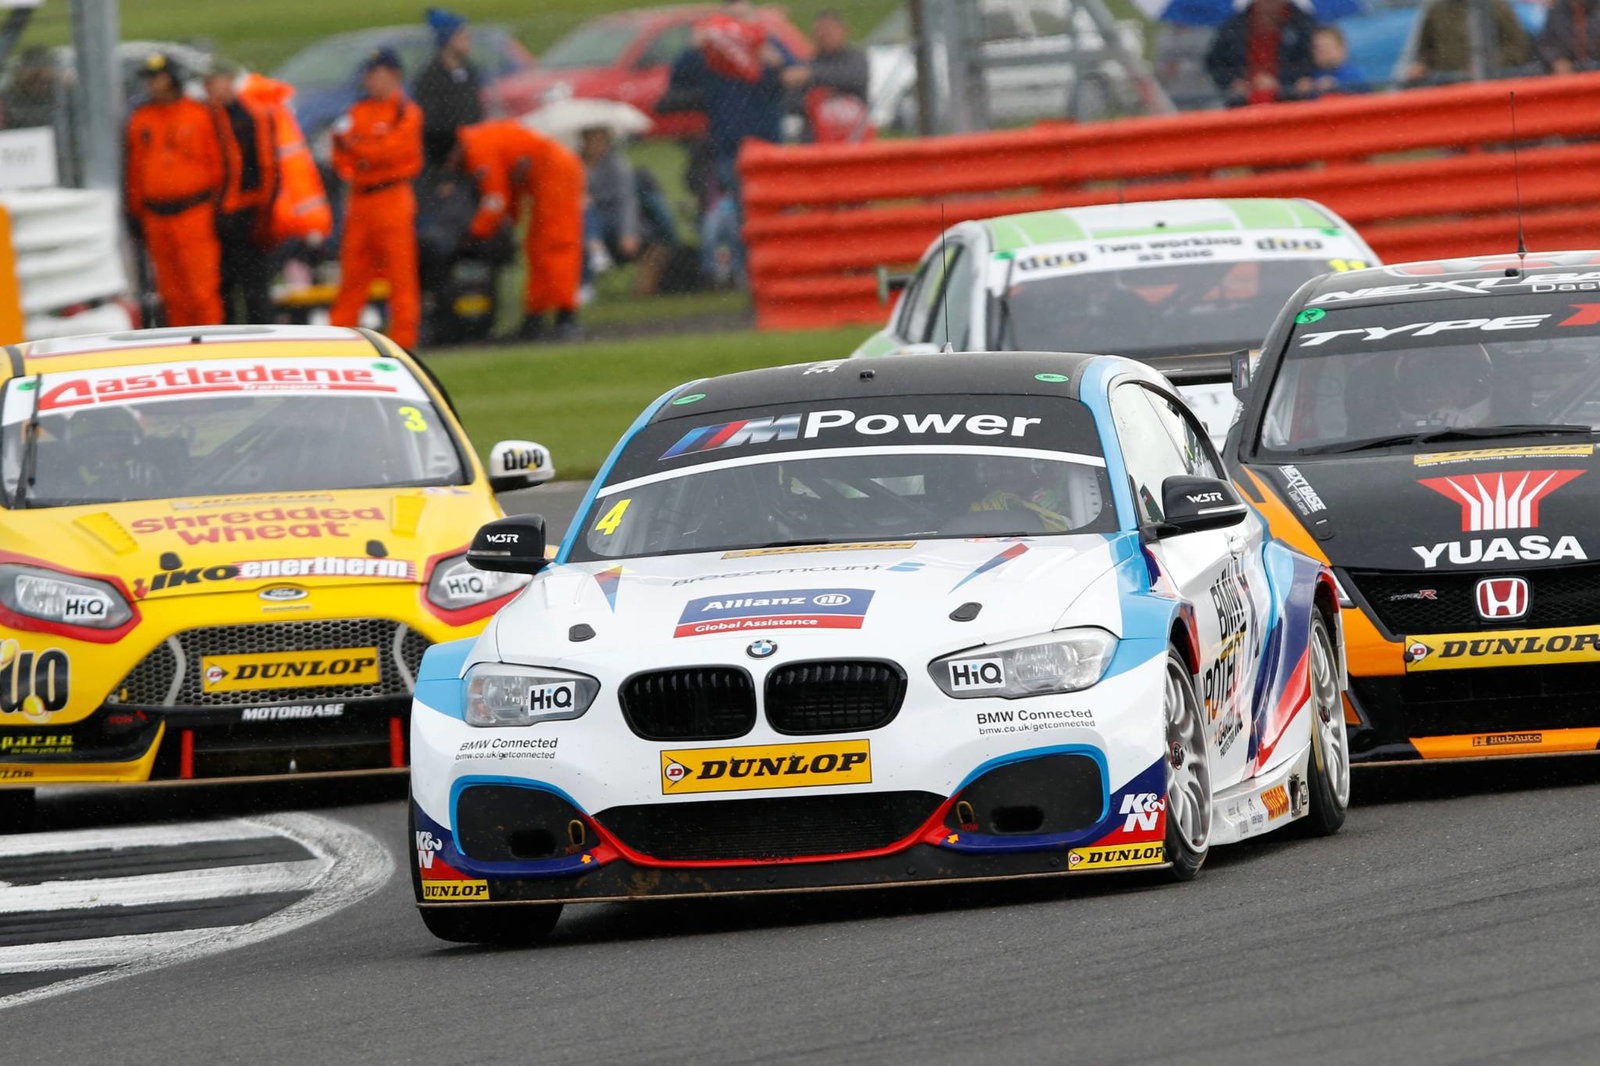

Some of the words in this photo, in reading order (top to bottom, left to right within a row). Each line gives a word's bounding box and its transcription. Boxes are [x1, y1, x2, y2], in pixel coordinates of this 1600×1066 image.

[1096, 242, 1142, 255] Two
[1149, 236, 1243, 250] working
[1532, 281, 1600, 292] Das
[1299, 313, 1552, 347] TYPE
[399, 406, 429, 432] 3
[131, 506, 386, 534] shredded
[595, 499, 631, 535] 4
[1412, 534, 1588, 569] YUASA
[240, 556, 408, 579] enertherm
[447, 576, 485, 595] HiQ
[65, 600, 105, 616] HiQ
[701, 596, 807, 612] Allianz
[694, 620, 741, 632] Global
[743, 617, 819, 628] Assistance
[1438, 633, 1600, 658] DUNLOP
[232, 657, 376, 680] DUNLOP
[952, 662, 1003, 686] HiQ
[530, 686, 573, 711] HiQ
[241, 703, 345, 720] MOTORBASE
[977, 711, 1014, 725] BMW
[1018, 708, 1094, 722] Connected
[978, 720, 1096, 736] bmw.co.uk/getconnected
[459, 739, 491, 752] BMW
[491, 737, 559, 749] Connected
[1489, 734, 1543, 744] HubAuto
[696, 752, 868, 780] DUNLOP
[1087, 848, 1164, 864] DUNLOP
[424, 885, 488, 897] DUNLOP
